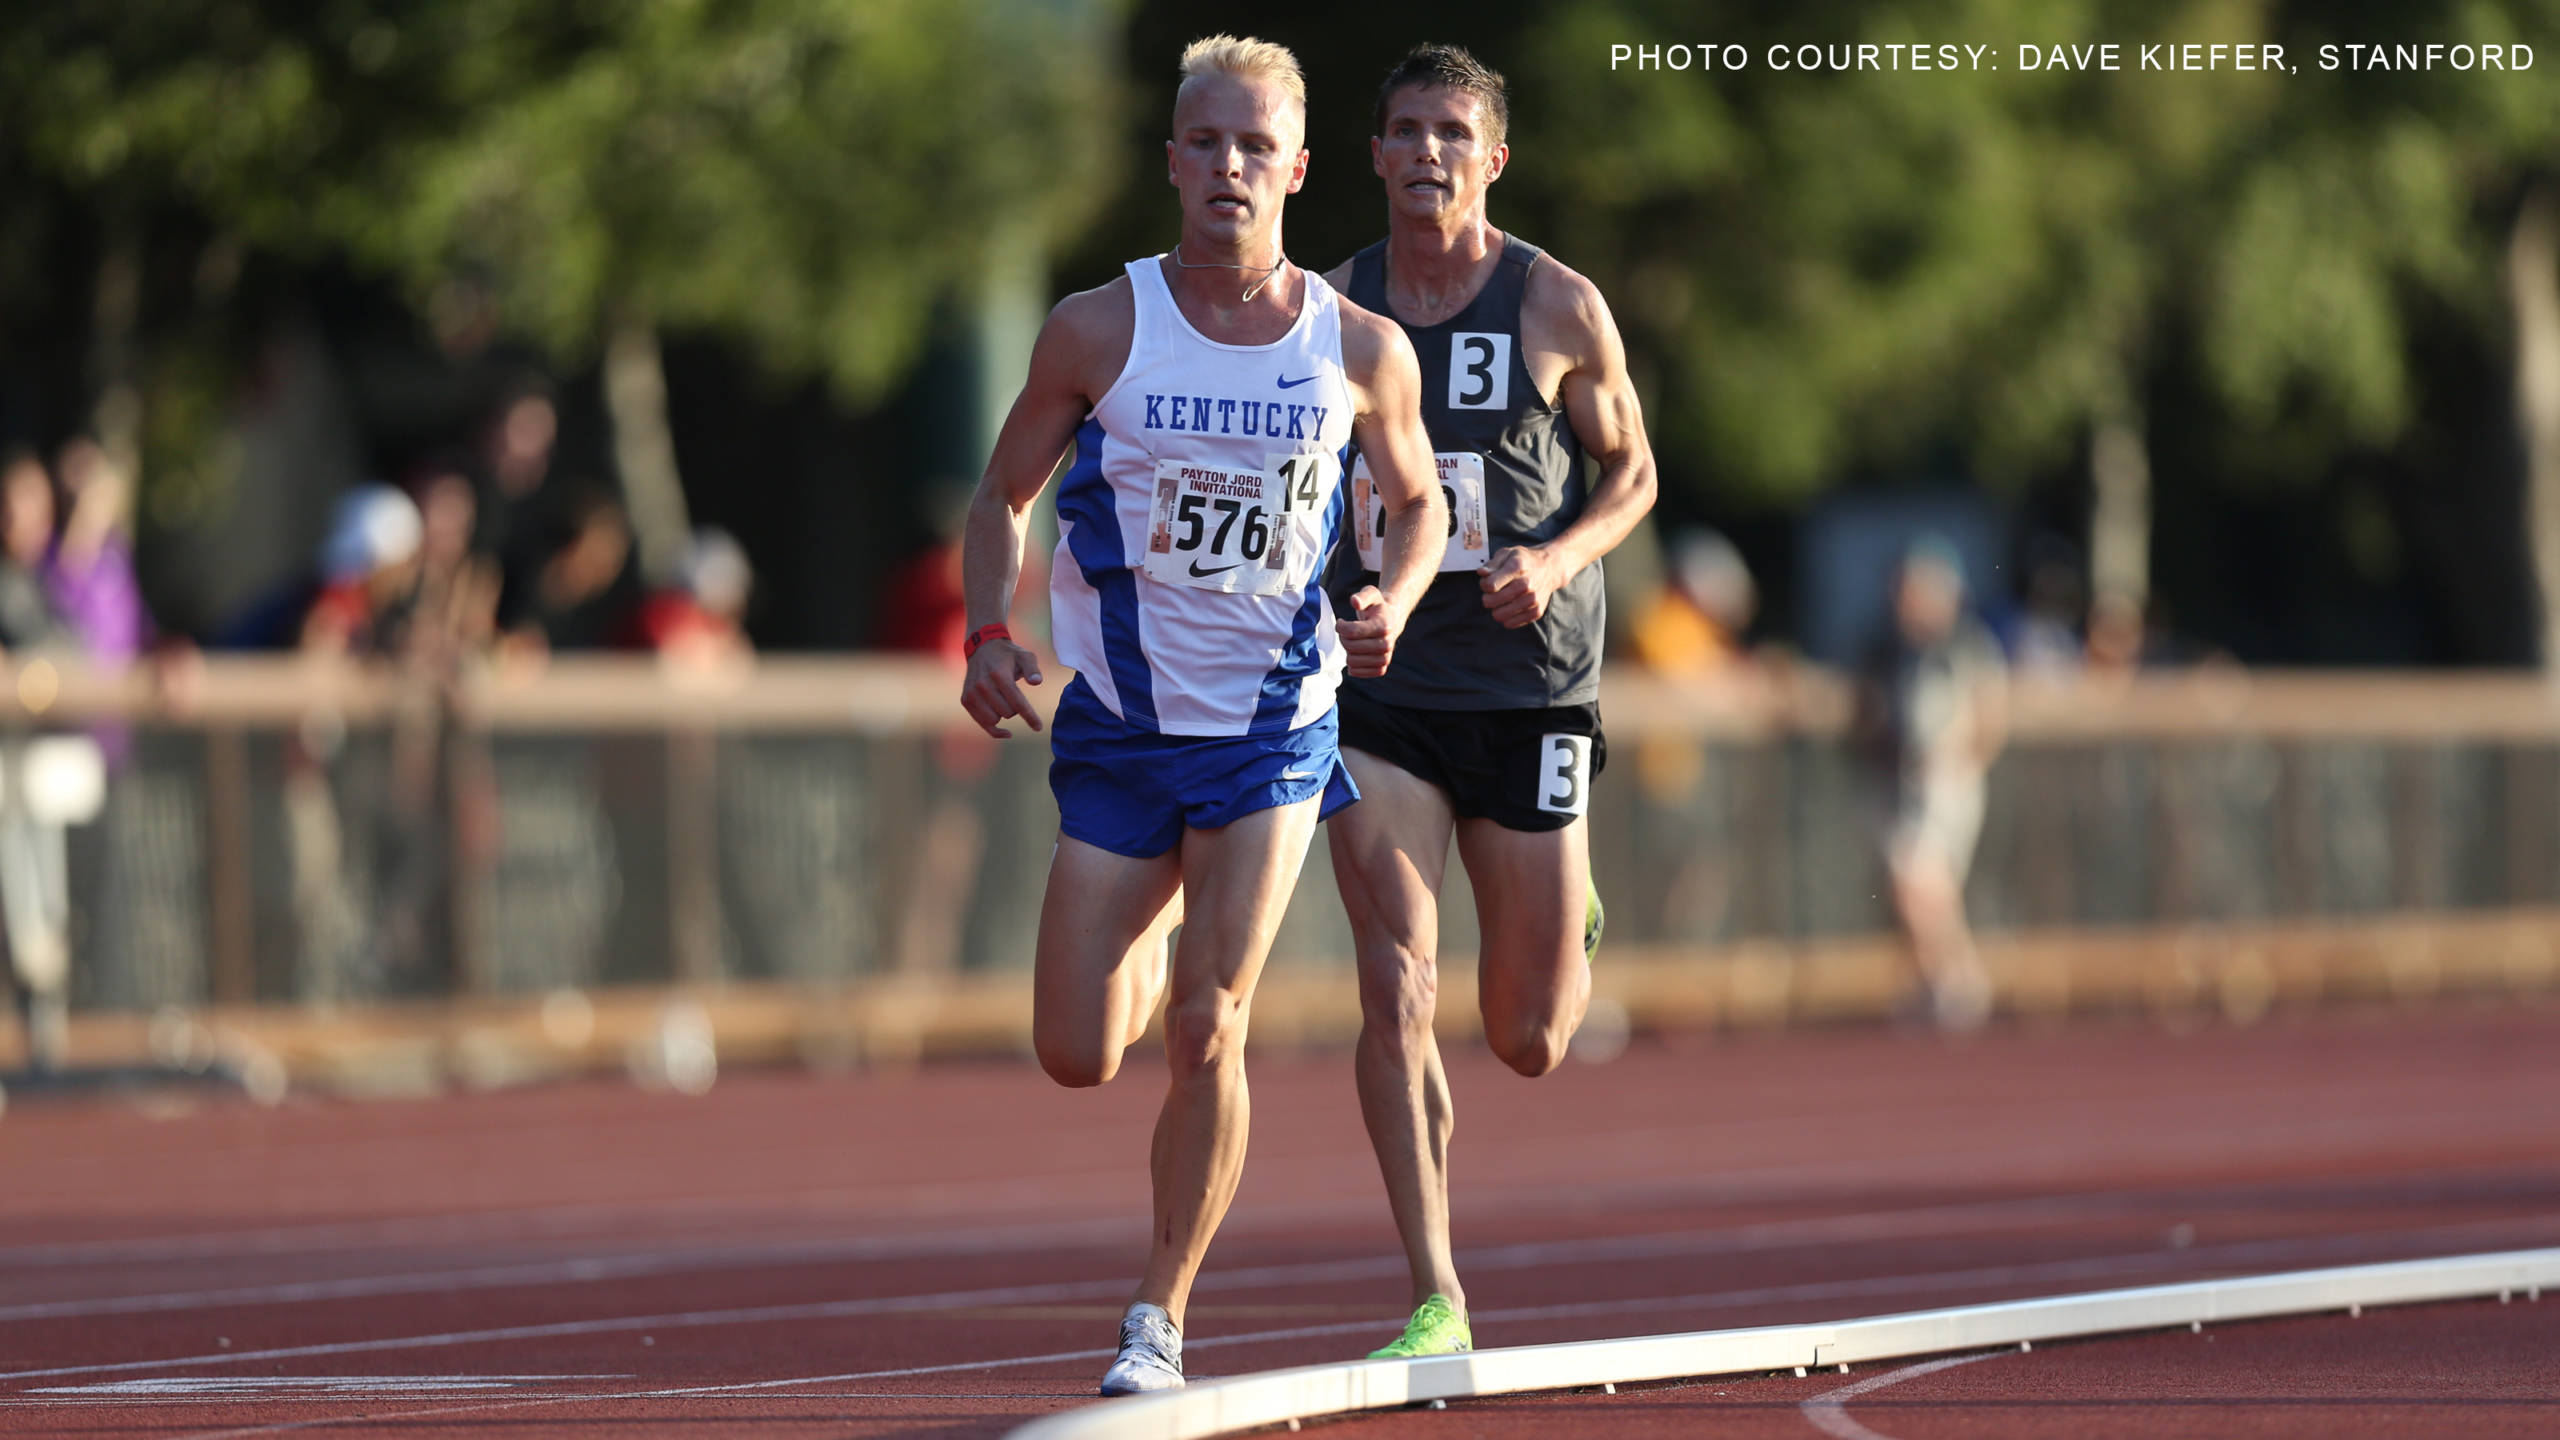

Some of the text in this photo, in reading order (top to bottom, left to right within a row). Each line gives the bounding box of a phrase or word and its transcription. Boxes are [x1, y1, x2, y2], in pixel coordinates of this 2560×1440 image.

[1460, 336, 1495, 405] 3
[1145, 395, 1328, 441] KENTUCKY
[1181, 468, 1263, 488] PAYTON JORD
[1189, 479, 1263, 499] INVITATIONA
[1277, 459, 1319, 512] 14
[1175, 494, 1268, 560] 576
[1549, 738, 1581, 808] 3
